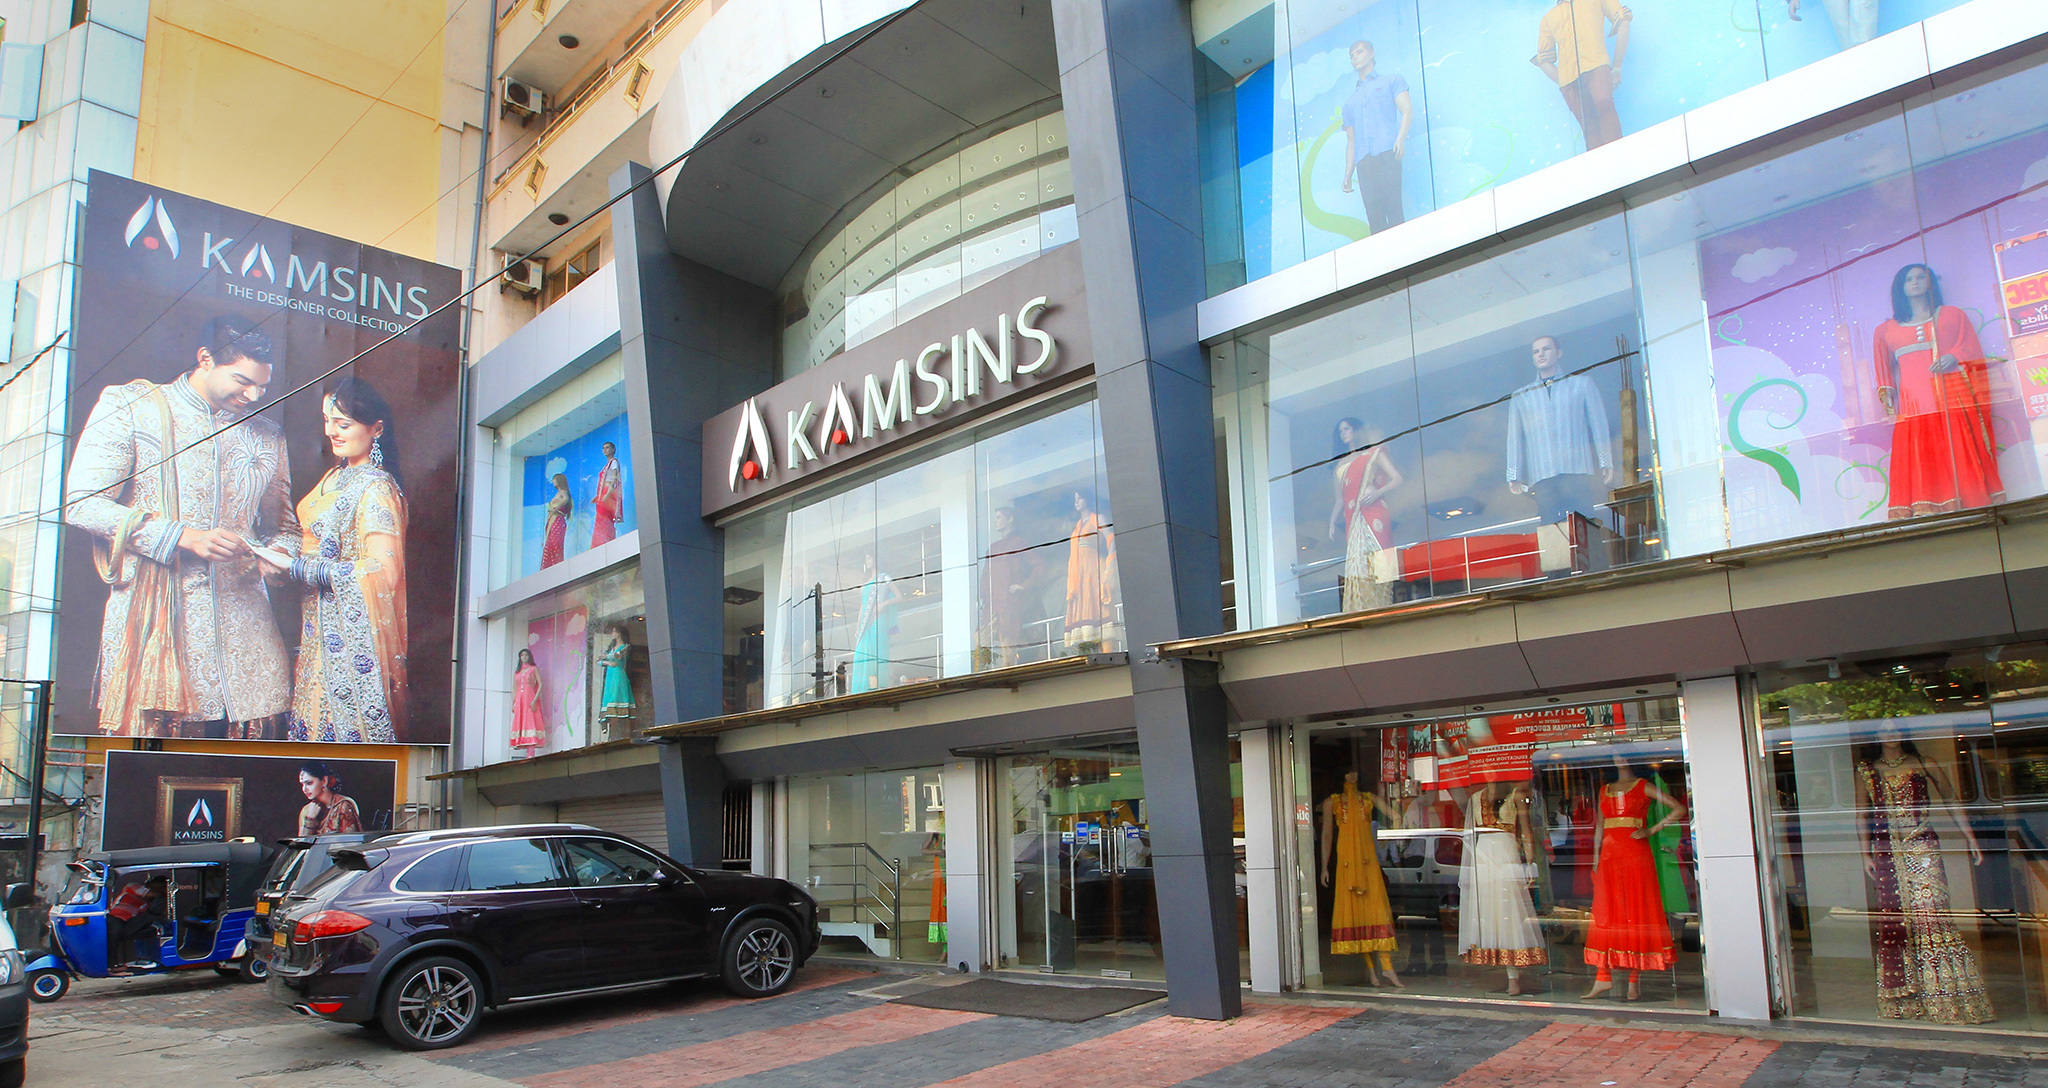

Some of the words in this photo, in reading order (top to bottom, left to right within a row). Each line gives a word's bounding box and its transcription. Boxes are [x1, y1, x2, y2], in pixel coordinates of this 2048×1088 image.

[202, 232, 430, 320] KAMSINS
[225, 283, 254, 300] THE
[257, 291, 325, 316] DESIGNER
[328, 307, 408, 336] COLLECTION
[787, 296, 1057, 470] KAMSINS
[174, 830, 224, 840] KAMSINS
